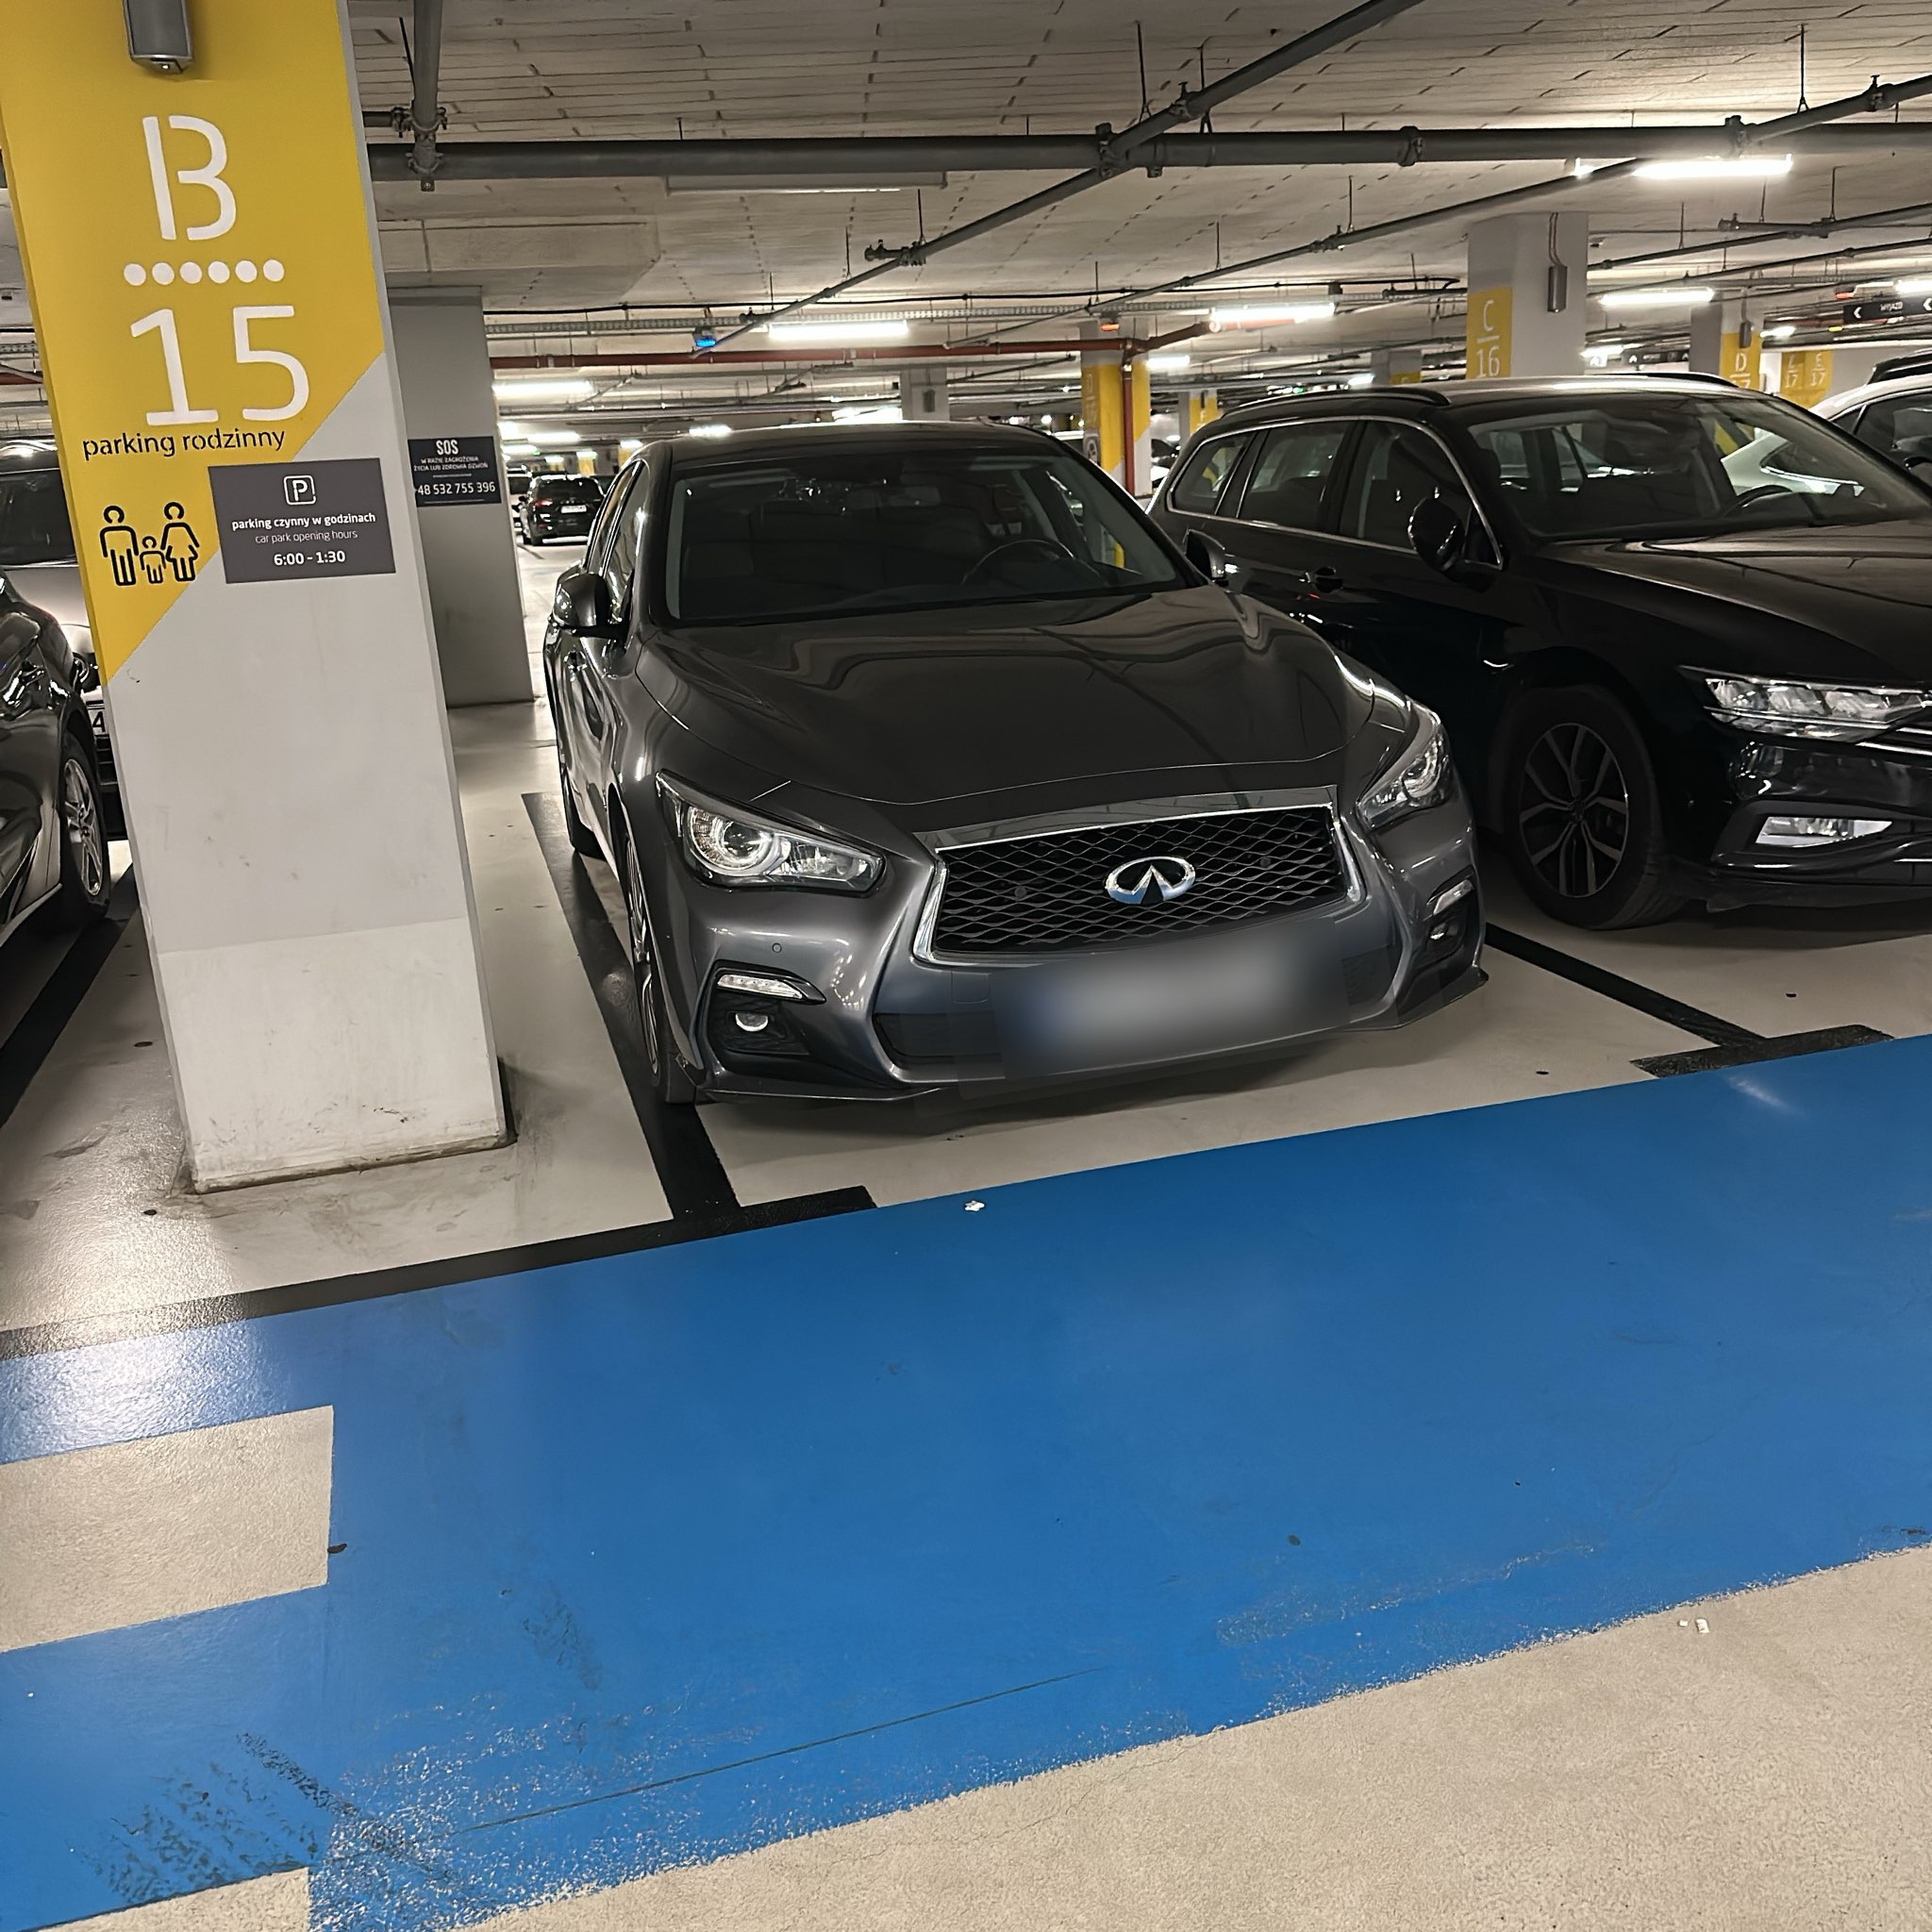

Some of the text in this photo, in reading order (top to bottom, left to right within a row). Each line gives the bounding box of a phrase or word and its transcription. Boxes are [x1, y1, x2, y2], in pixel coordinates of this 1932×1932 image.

[142, 115, 237, 241] B
[1483, 299, 1494, 332] C
[130, 305, 309, 426] 15
[1476, 345, 1500, 378] 16
[1736, 353, 1747, 372] D
[83, 428, 285, 461] parking rodzinny
[436, 440, 458, 455] SOS
[433, 483, 453, 495] 532
[455, 482, 474, 494] 755
[476, 481, 496, 492] 396
[232, 519, 272, 531] parking
[274, 516, 309, 528] czynny
[325, 512, 376, 526] godzinach
[255, 529, 358, 544] car park opening hours
[274, 553, 305, 566] 6:00
[316, 550, 346, 563] 1:30
